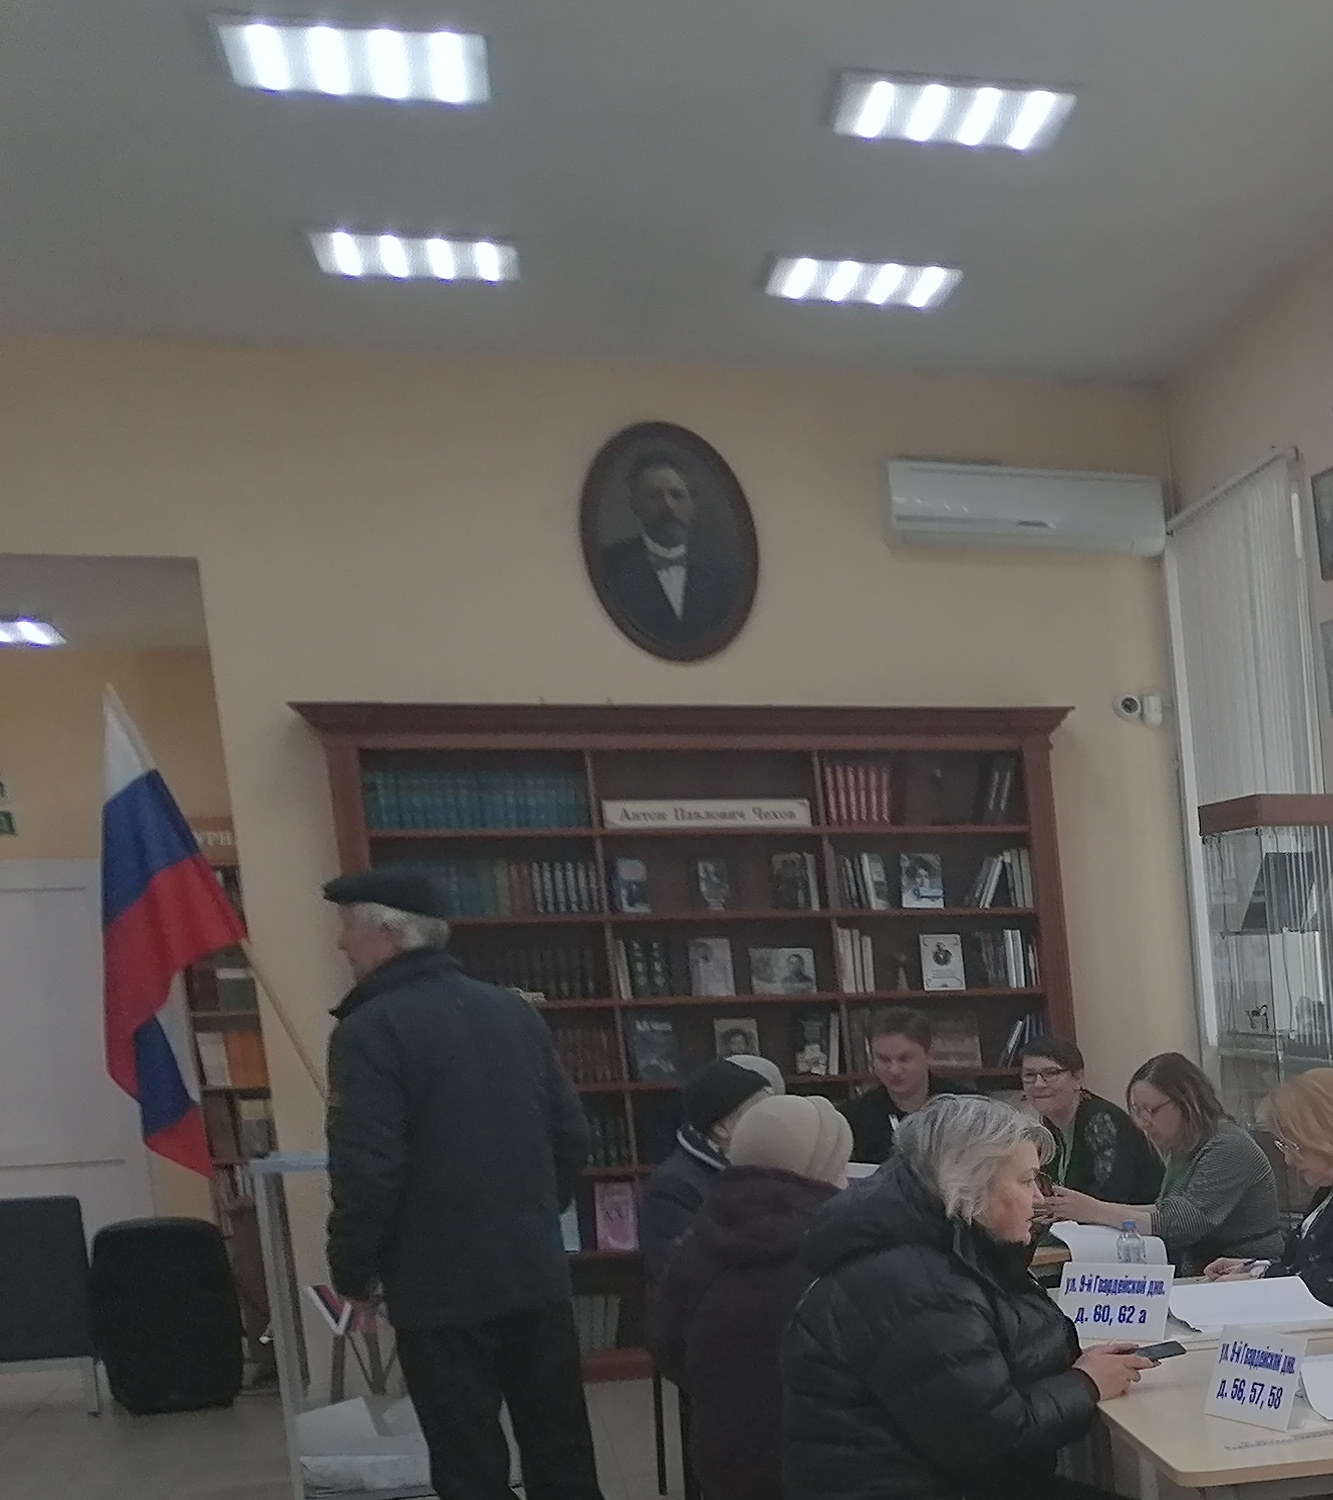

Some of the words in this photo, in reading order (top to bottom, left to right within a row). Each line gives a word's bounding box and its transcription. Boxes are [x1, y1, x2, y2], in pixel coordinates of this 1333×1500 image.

[1074, 1307, 1088, 1324] д.
[1093, 1304, 1113, 1326] 60,
[1118, 1305, 1135, 1324] 62
[1138, 1309, 1147, 1324] а
[1216, 1379, 1227, 1399] д.
[1231, 1378, 1246, 1405] 56,
[1249, 1382, 1265, 1409] 57,
[1267, 1386, 1283, 1409] 58
